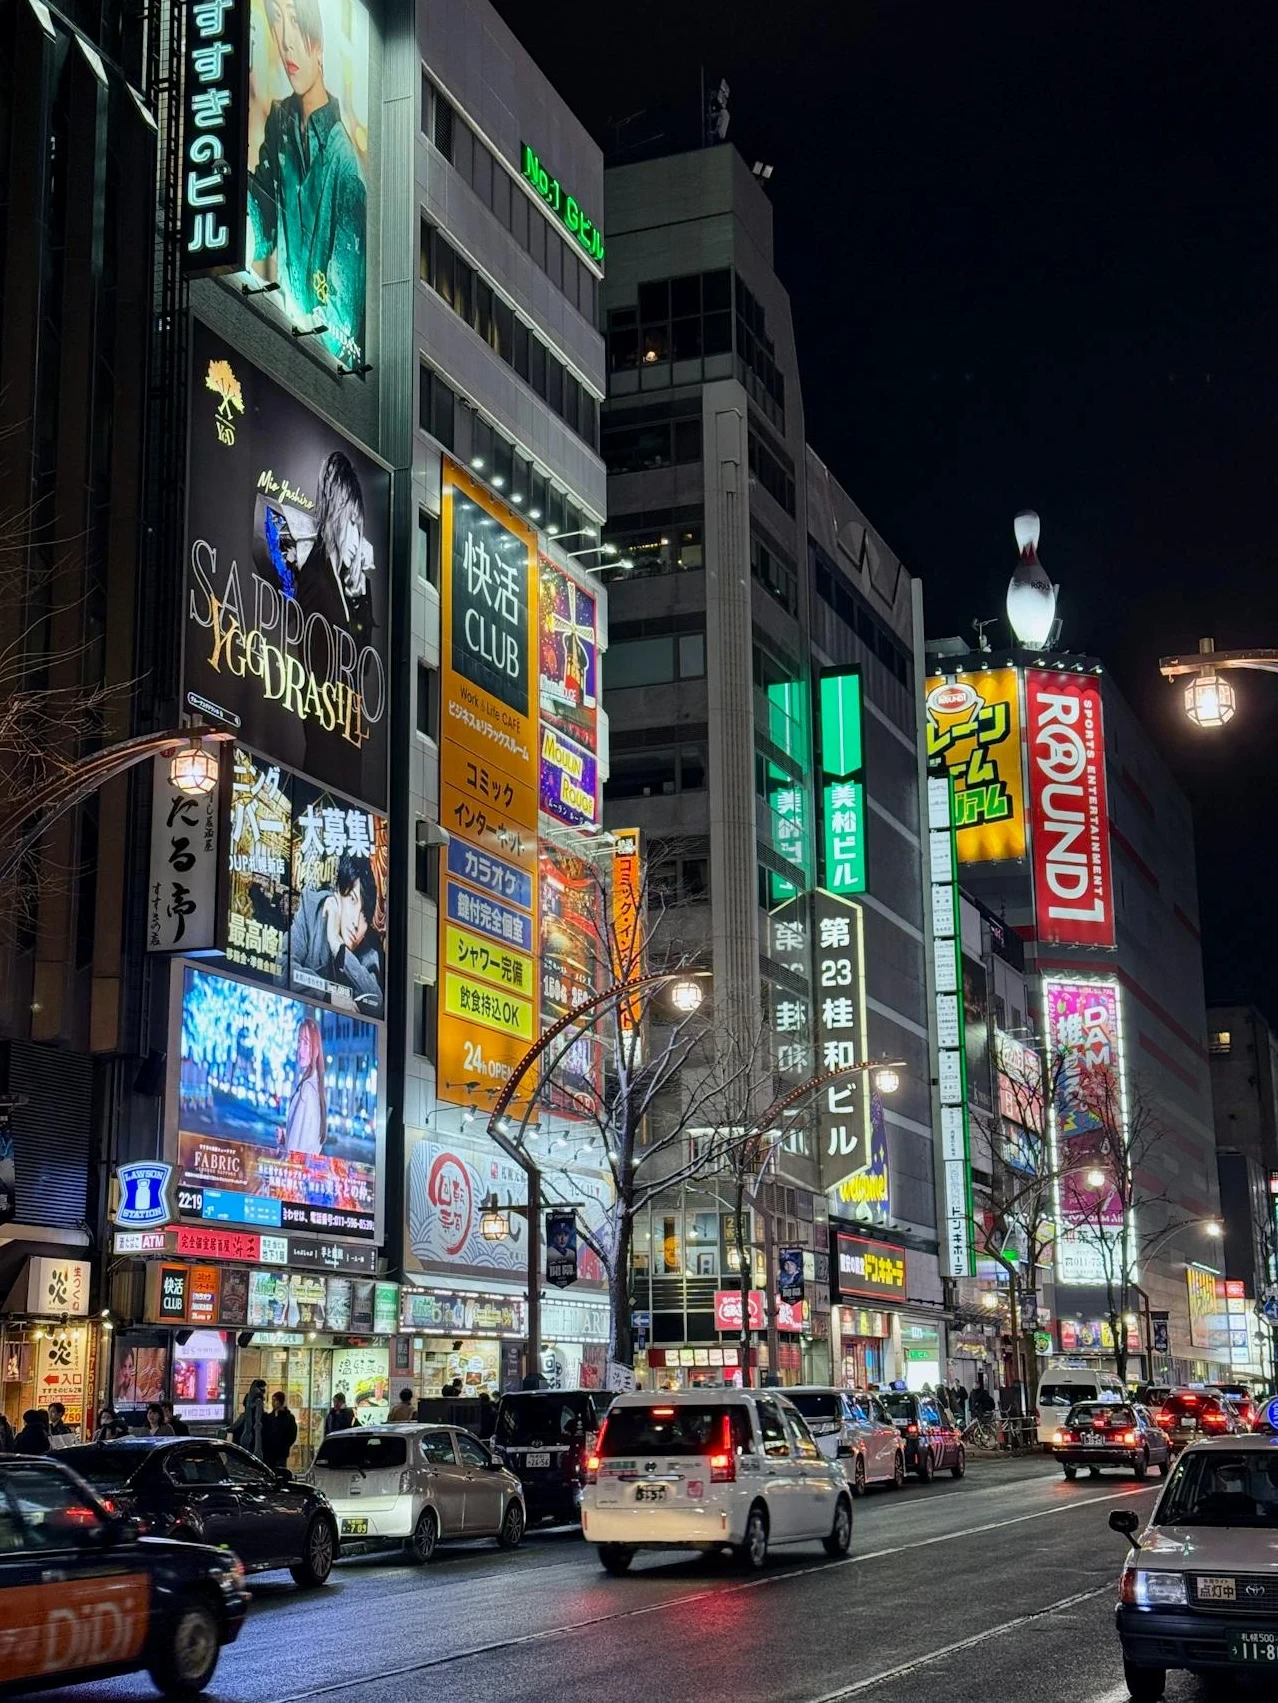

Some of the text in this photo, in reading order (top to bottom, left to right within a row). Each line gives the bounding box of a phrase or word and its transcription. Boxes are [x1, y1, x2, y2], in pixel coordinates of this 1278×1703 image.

[463, 531, 519, 627] 快活
[464, 607, 520, 680] CLUB
[460, 686, 479, 709] Work
[486, 703, 501, 722] Life
[544, 735, 582, 774] MOULIN
[466, 761, 514, 807] コミック
[563, 779, 593, 813] ROUGE
[1083, 699, 1104, 896] SPORTS ENTERTAINMENT
[454, 799, 525, 857] インターネット
[1036, 692, 1105, 923] ROUND1
[297, 804, 376, 858] 大募集!
[831, 784, 858, 888] 美松ビル
[465, 850, 517, 896] カラオケ
[458, 938, 523, 987] シャワー完備
[460, 984, 521, 1028] 飲食持込OK
[820, 917, 858, 1158] 第23桂和ビル
[124, 1169, 164, 1182] LAWSON
[194, 1151, 240, 1173] FABRIC
[122, 1208, 163, 1220] STATION
[178, 1192, 202, 1209] 22:19
[142, 1234, 165, 1249] ATM
[163, 1276, 184, 1296] 快活
[163, 1298, 183, 1310] CLUB
[61, 1373, 82, 1385] 入口
[1199, 1585, 1234, 1599] 点灯中
[43, 1597, 134, 1670] DiDi
[1258, 1632, 1275, 1643] 500
